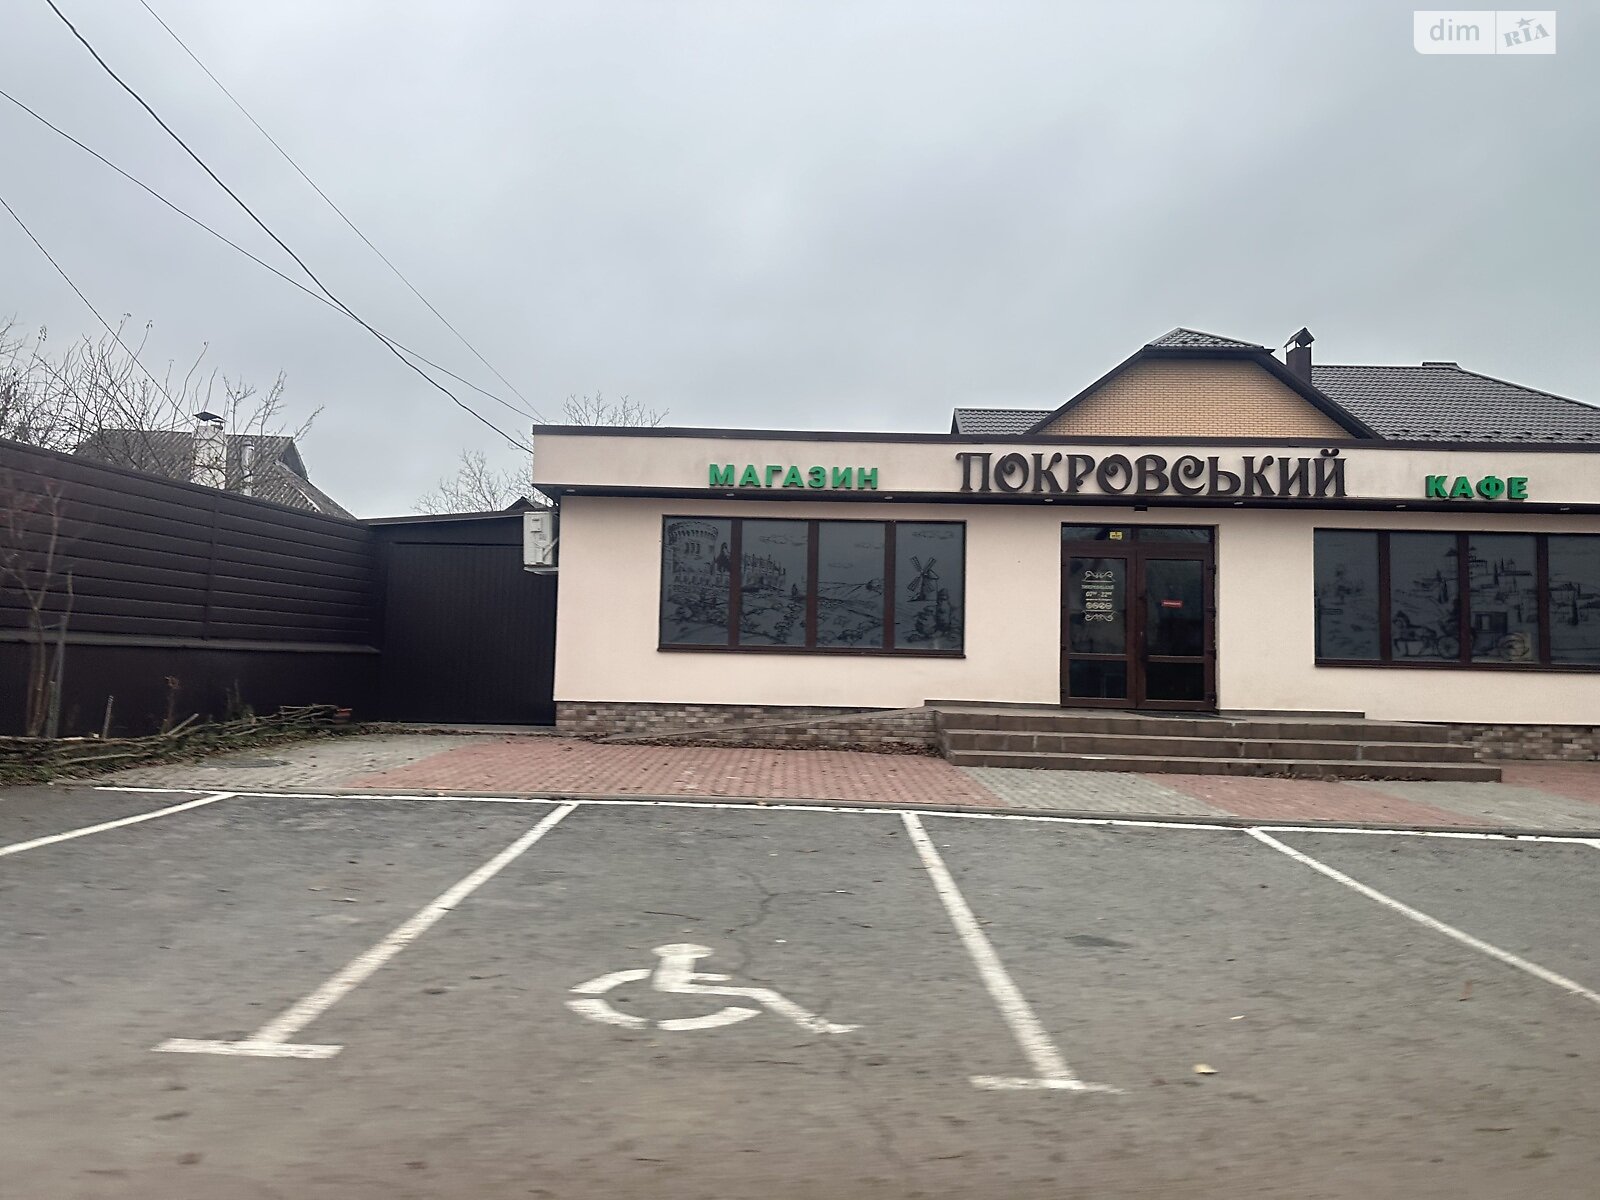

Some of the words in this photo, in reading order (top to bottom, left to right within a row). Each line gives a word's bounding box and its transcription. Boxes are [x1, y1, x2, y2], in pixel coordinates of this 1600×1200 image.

[708, 463, 879, 490] МАГАЗИН
[955, 448, 1348, 497] ПОКРОВСЬКИЙ
[1425, 474, 1529, 501] КАФЕ
